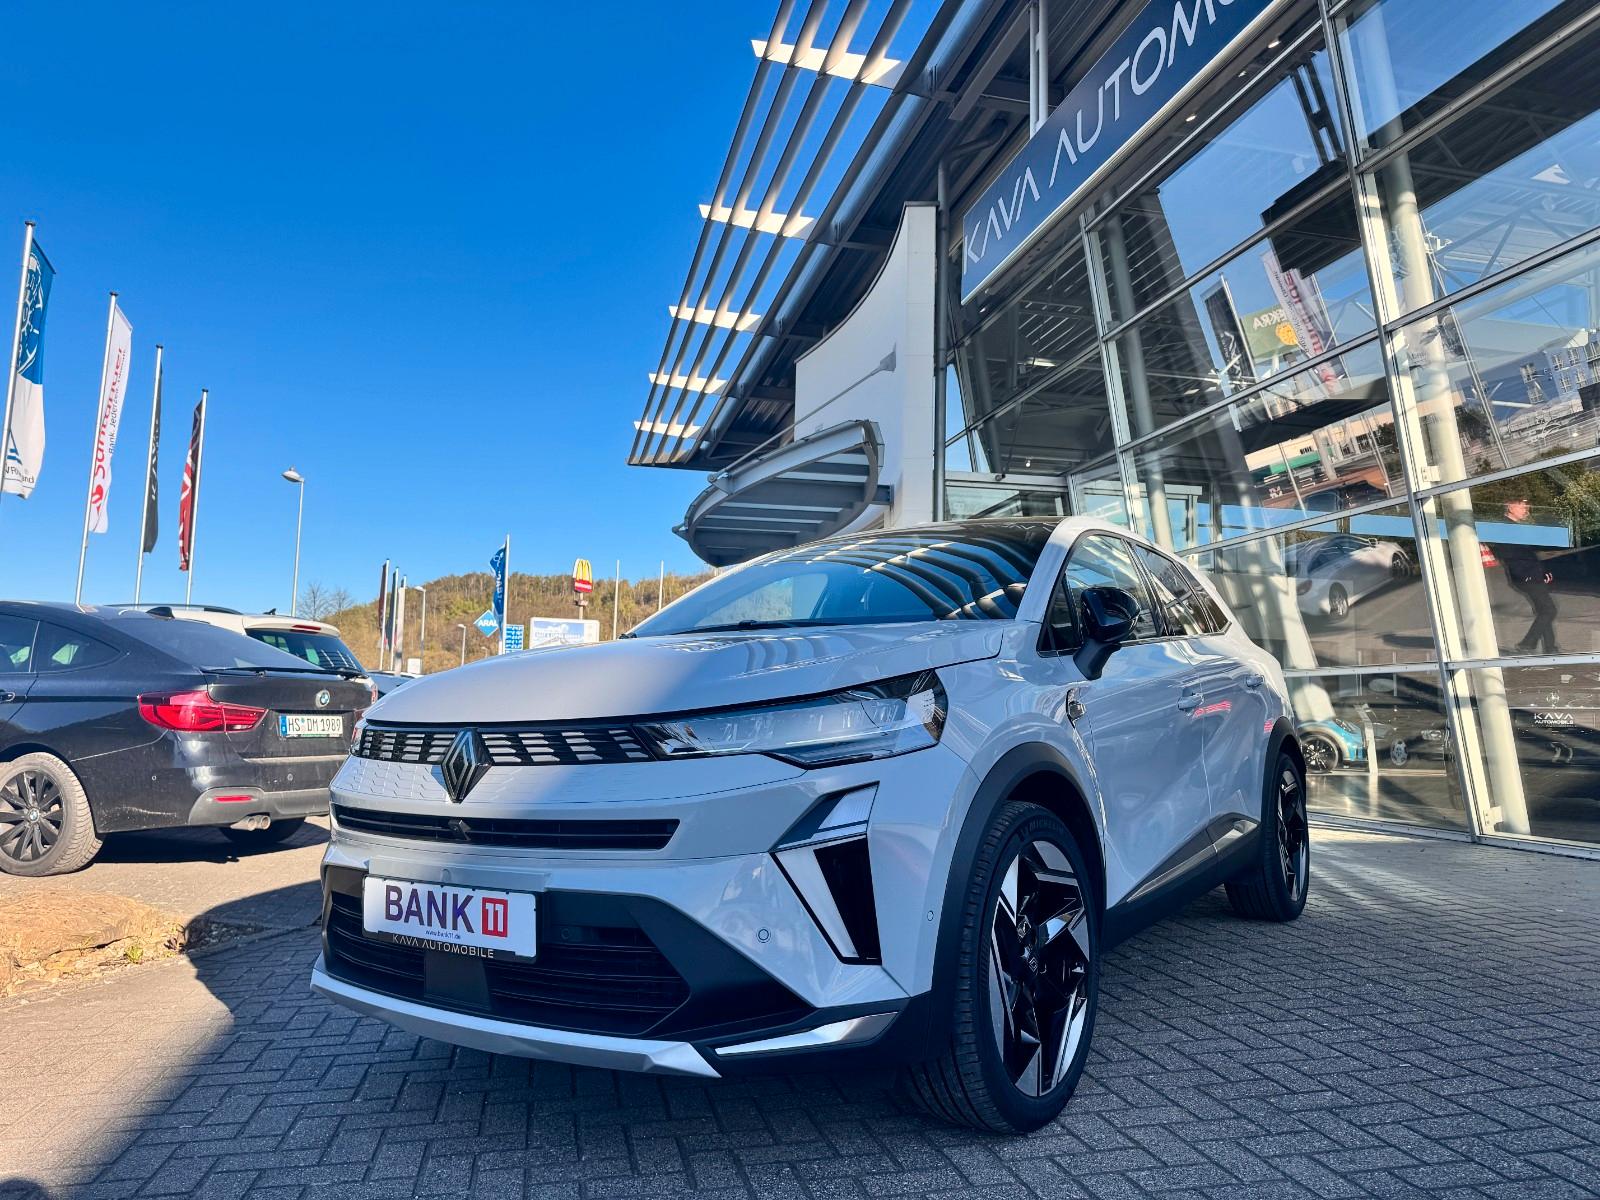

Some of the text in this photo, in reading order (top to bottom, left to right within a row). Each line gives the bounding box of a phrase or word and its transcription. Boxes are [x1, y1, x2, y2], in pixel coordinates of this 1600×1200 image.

[963, 0, 1235, 275] KAVA AUTOM
[288, 718, 301, 732] HS
[306, 718, 319, 732] DM
[1534, 712, 1574, 720] KAVA
[385, 885, 506, 934] BANK 11
[392, 933, 494, 959] KAVA AUTOMOBILE
